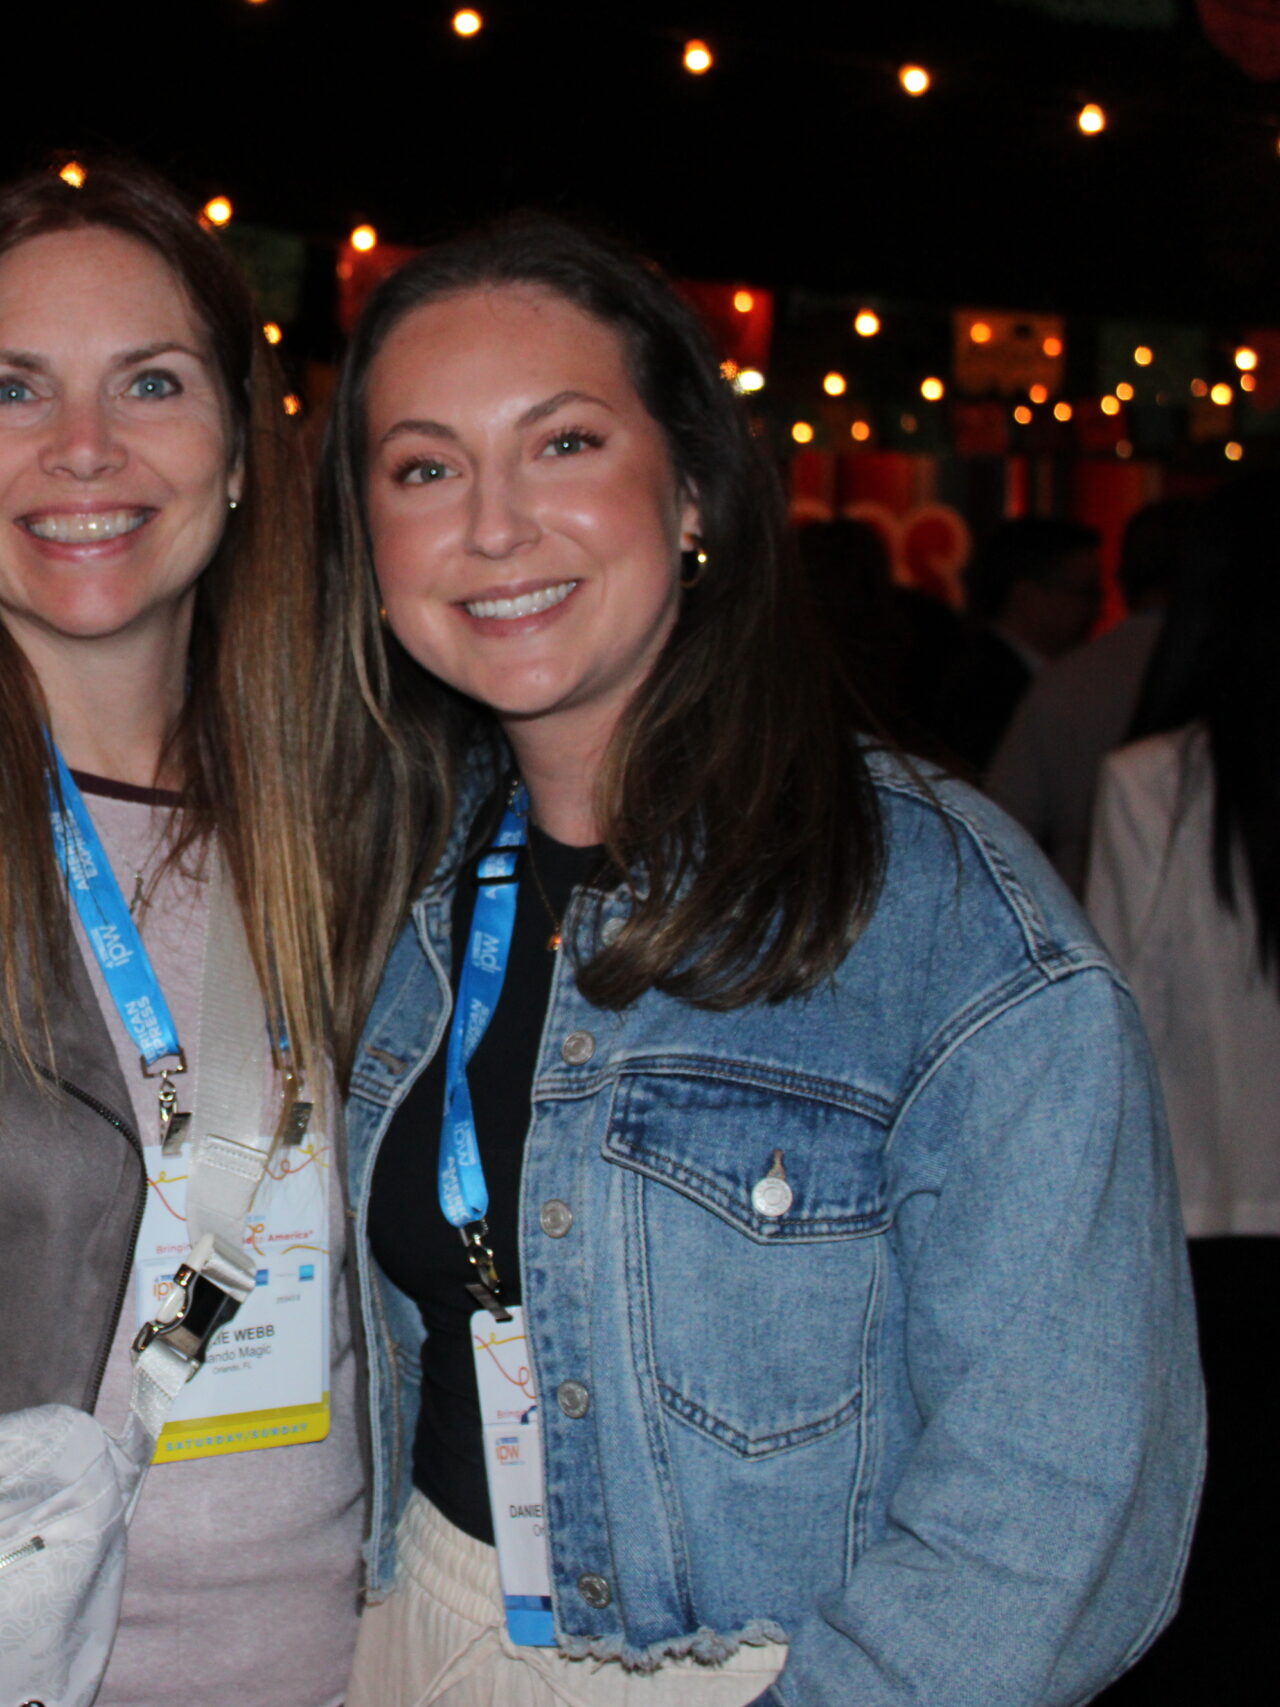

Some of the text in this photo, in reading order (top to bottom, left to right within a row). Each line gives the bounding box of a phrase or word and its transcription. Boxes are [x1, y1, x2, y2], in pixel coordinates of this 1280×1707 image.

[235, 1324, 275, 1342] WEBB
[239, 1344, 272, 1359] Magic
[510, 1504, 544, 1518] DANIE
